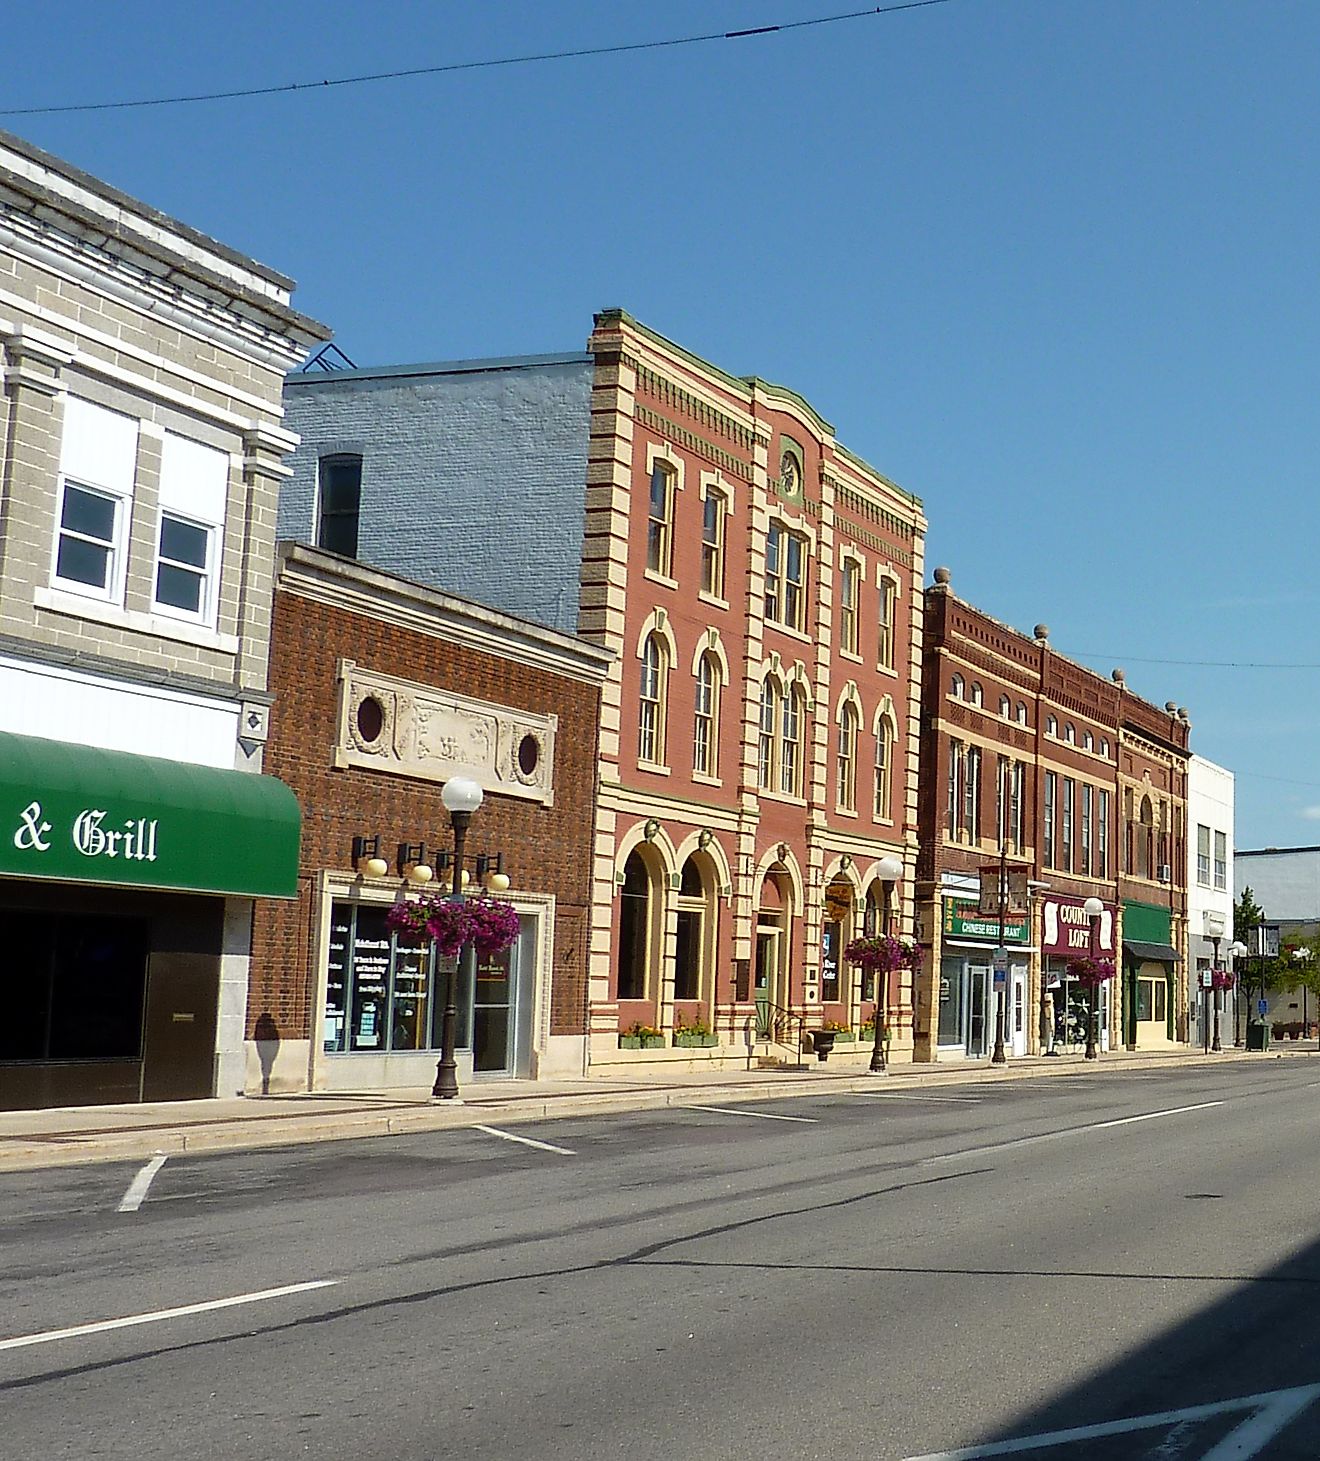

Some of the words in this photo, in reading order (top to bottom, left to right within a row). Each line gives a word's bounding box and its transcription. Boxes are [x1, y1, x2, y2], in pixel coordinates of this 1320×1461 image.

[14, 801, 53, 851] &
[72, 809, 158, 862] Grill
[1060, 905, 1091, 926] COUNT
[961, 922, 986, 934] CHINESE
[986, 924, 1021, 937] RESTRANT
[1068, 928, 1090, 949] LOFT
